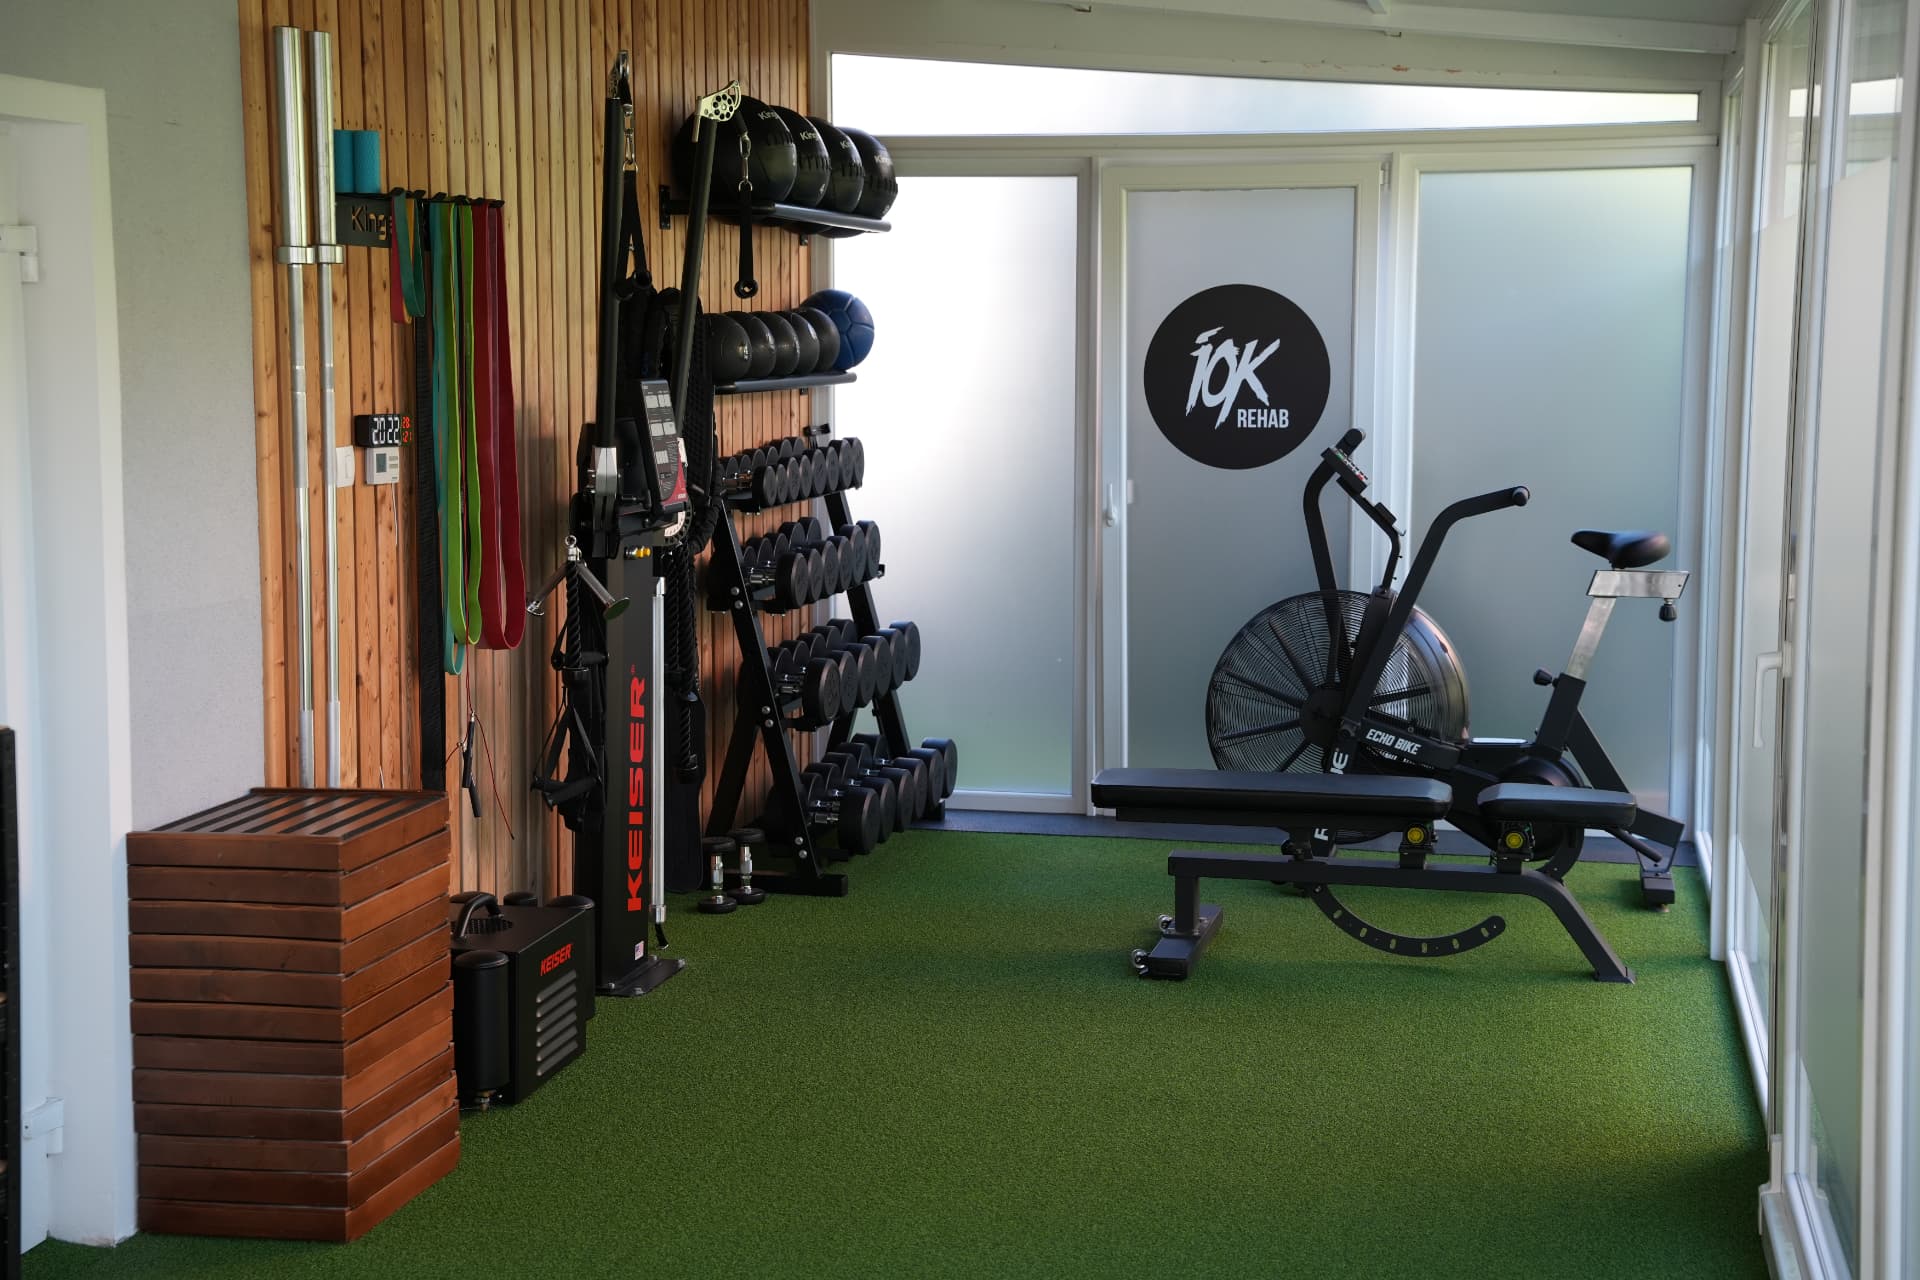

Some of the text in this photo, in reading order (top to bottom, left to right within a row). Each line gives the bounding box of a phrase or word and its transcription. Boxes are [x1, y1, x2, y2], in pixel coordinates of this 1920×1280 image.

[351, 204, 392, 241] King
[1237, 408, 1289, 428] REHAB
[1365, 728, 1395, 746] ECHO
[1394, 738, 1422, 756] BIKE
[627, 676, 646, 912] KEISER
[540, 943, 572, 977] KEISER
